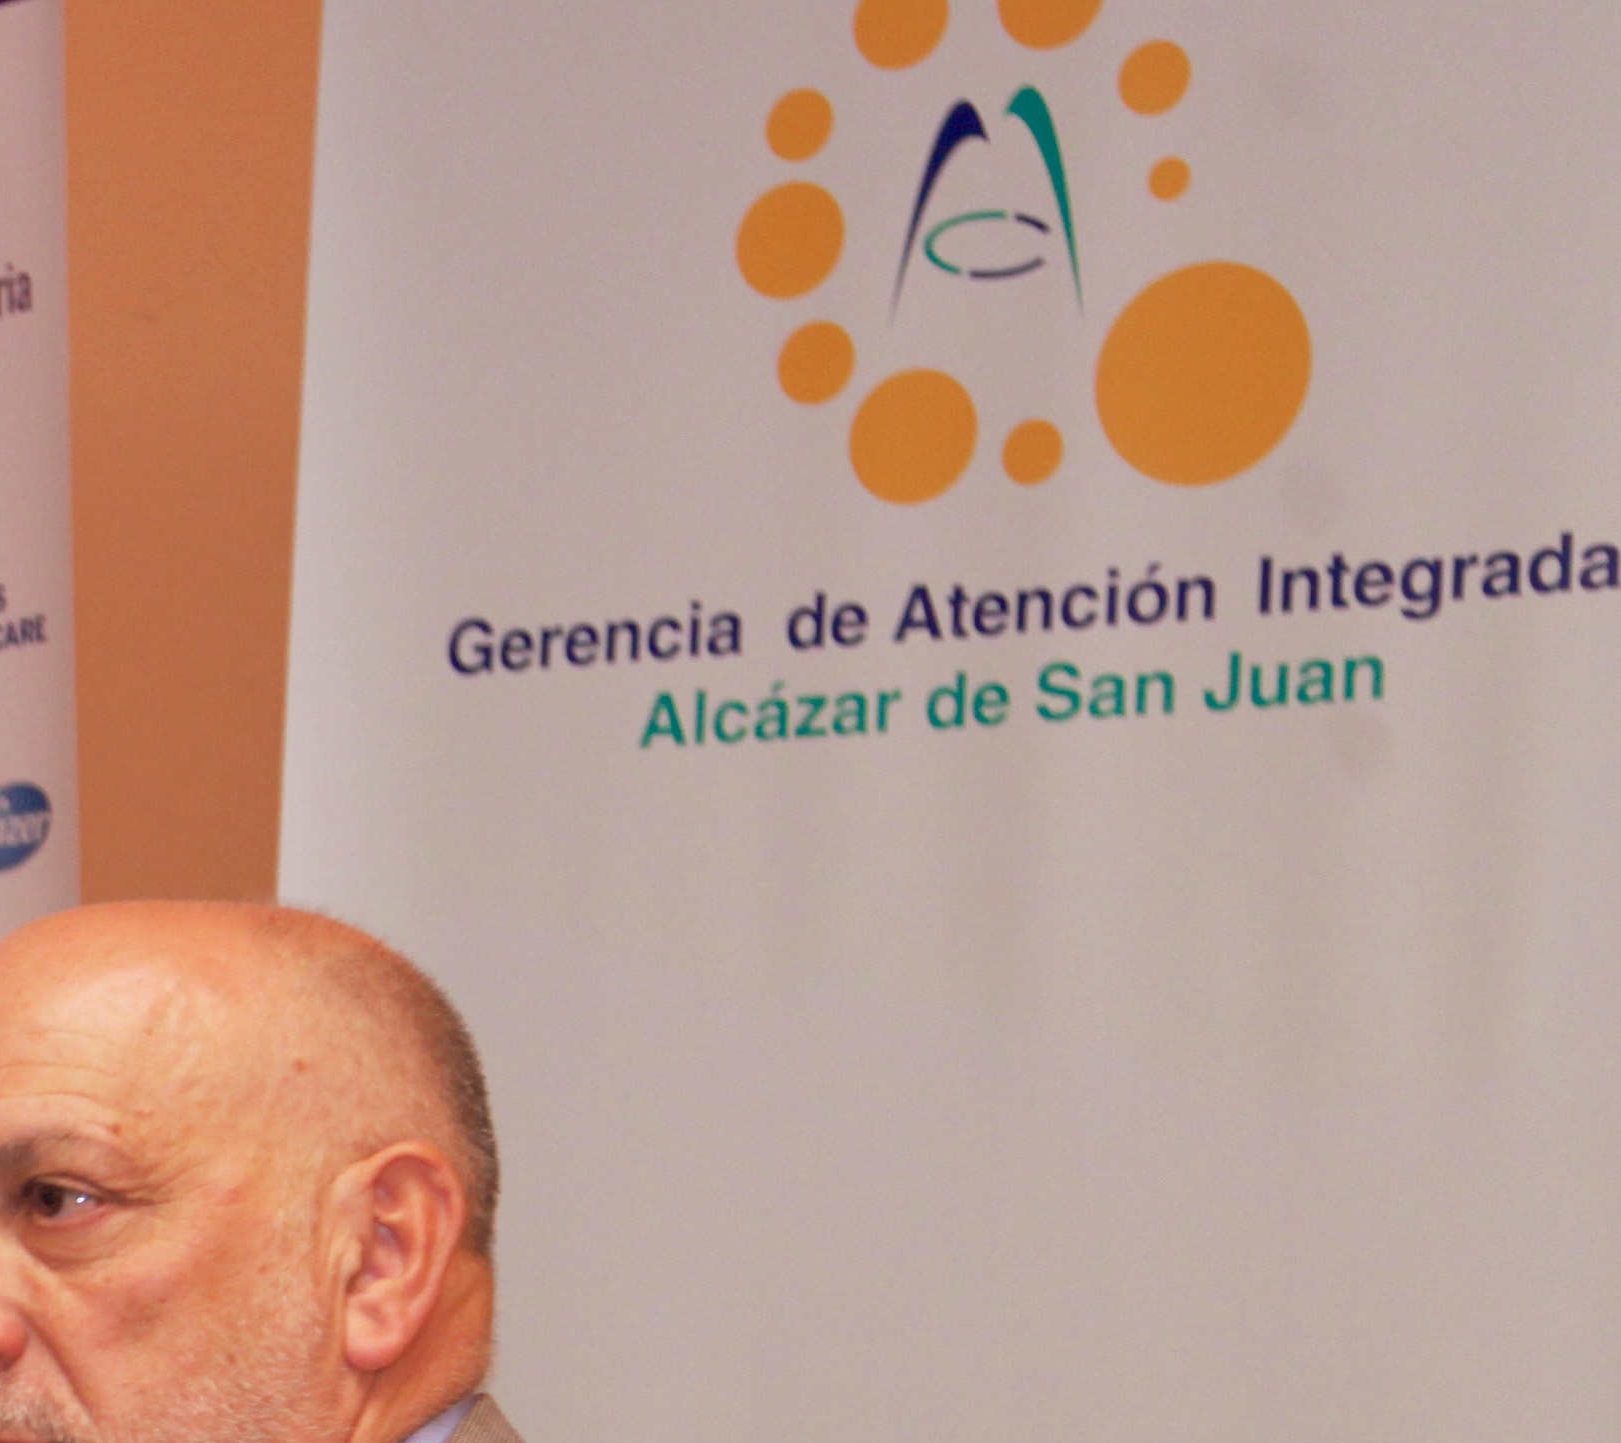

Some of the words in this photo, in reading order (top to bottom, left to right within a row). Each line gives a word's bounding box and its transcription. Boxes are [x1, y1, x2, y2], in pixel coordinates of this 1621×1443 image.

[446, 598, 744, 678] Gerencia
[785, 591, 870, 652] de
[892, 562, 1218, 645] Atención
[1256, 530, 1621, 622] Integrada
[639, 676, 903, 750] Alcázar
[926, 671, 1011, 730] de
[1034, 660, 1175, 724] San
[1202, 647, 1386, 713] Juan
